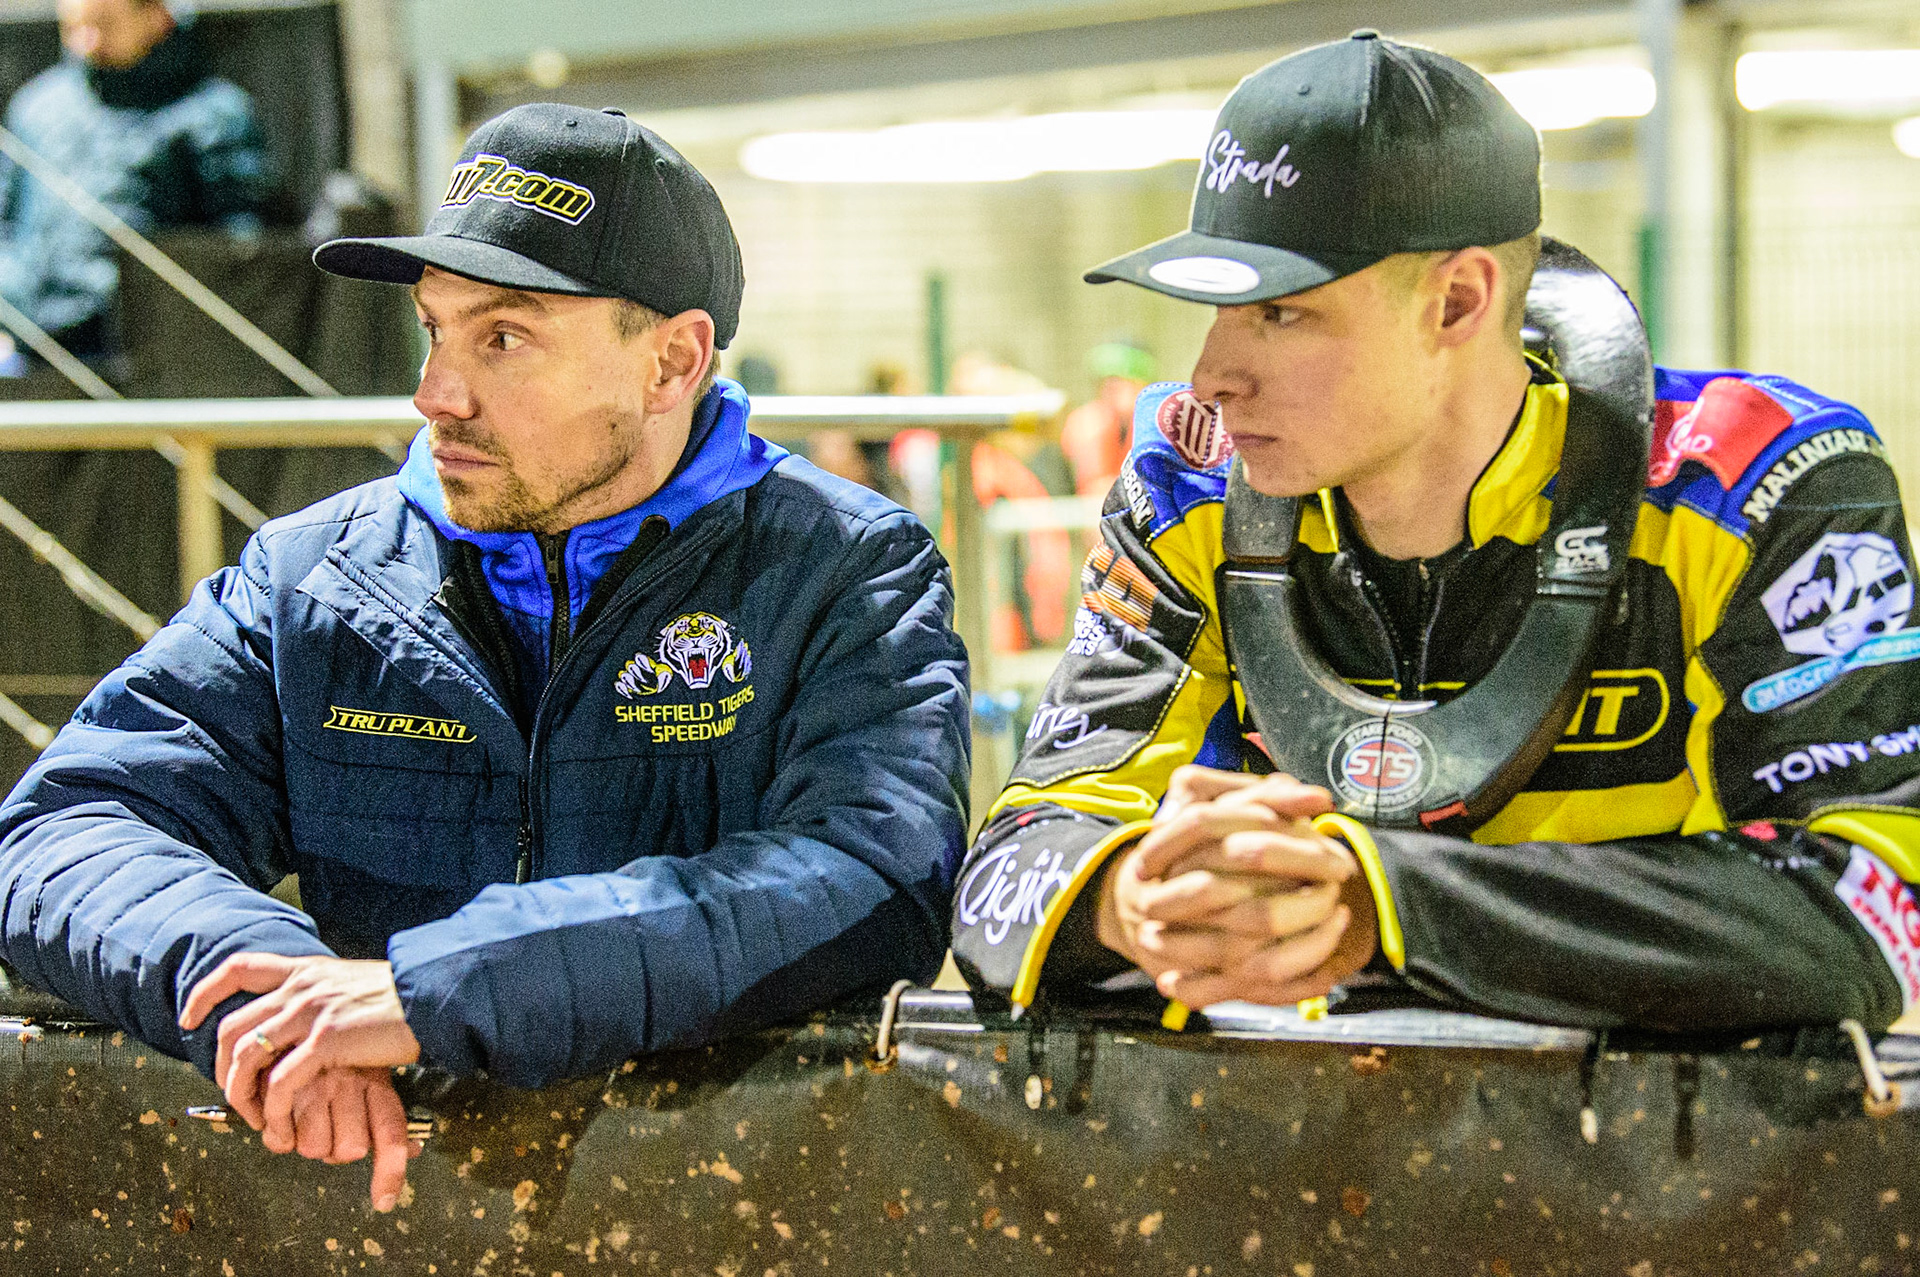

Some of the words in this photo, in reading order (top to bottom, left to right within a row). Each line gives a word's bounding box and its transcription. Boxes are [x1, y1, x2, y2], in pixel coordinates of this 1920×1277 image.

[1205, 128, 1300, 198] Strada
[615, 702, 714, 723] SHEFFIELD
[718, 685, 755, 715] TIGERS
[338, 711, 386, 731] TRU
[387, 718, 467, 739] PLANT
[651, 714, 737, 743] SPEEDWAY
[1345, 748, 1417, 779] STS
[1752, 741, 1870, 793] TONY
